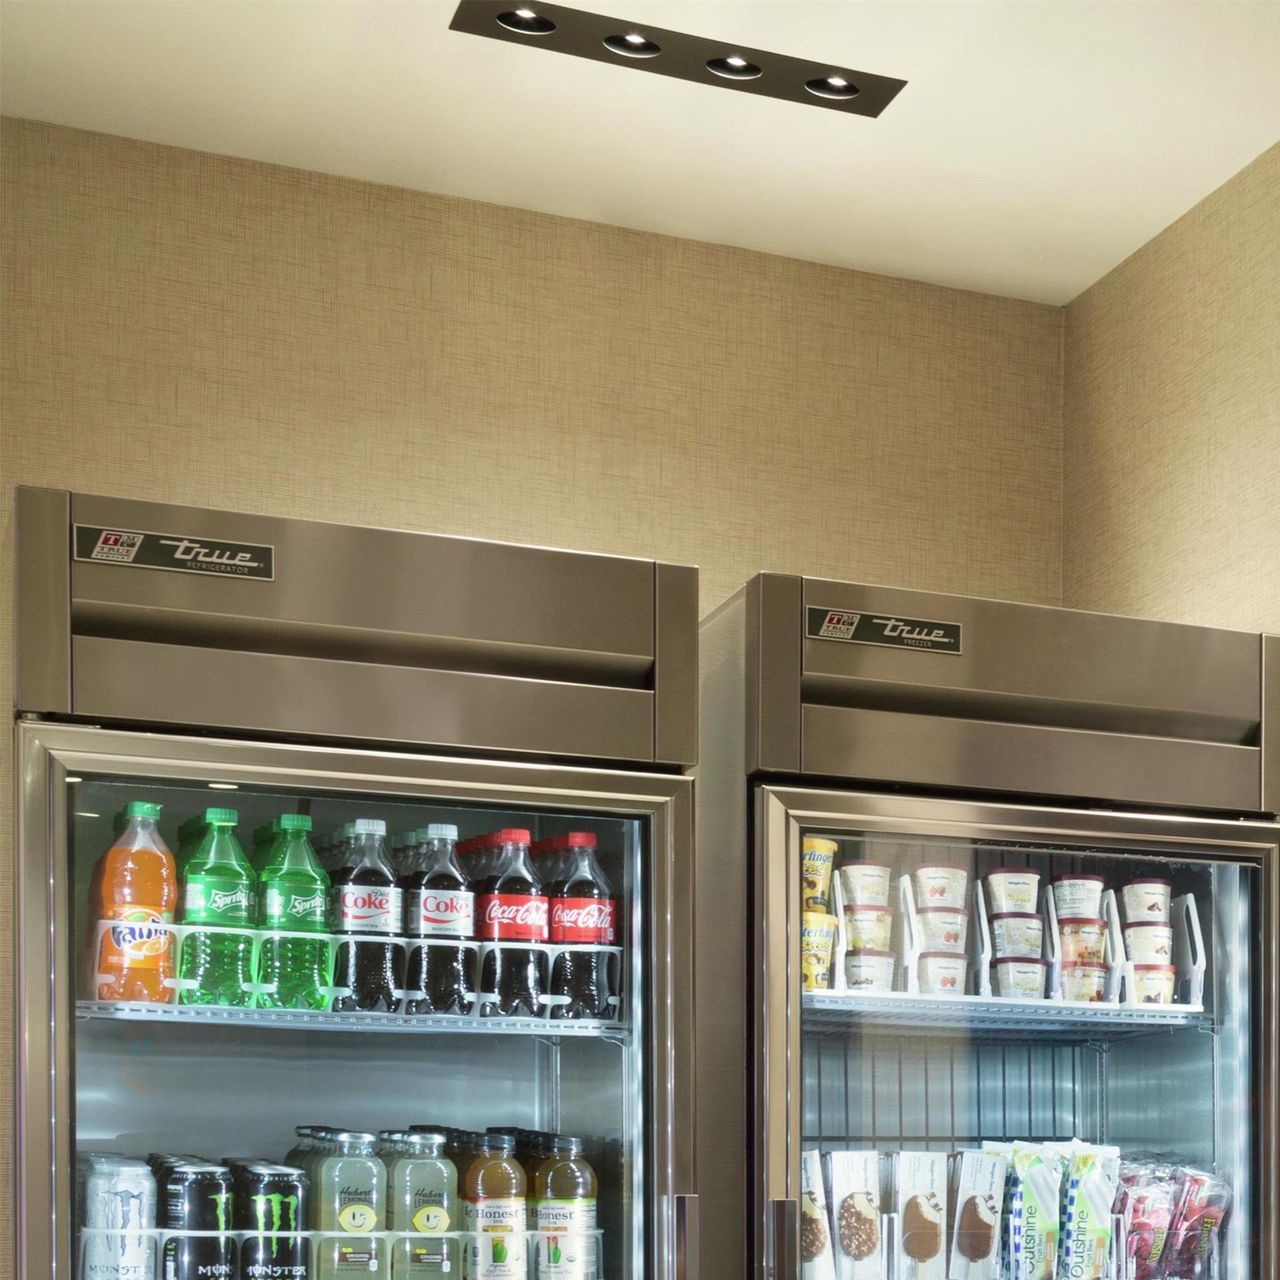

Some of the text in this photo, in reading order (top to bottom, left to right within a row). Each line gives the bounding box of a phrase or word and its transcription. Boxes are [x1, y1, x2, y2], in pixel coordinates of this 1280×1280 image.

[159, 540, 260, 568] true
[186, 560, 250, 575] REFRIGERATOR
[872, 619, 951, 643] true
[903, 638, 932, 648] FREEZER
[341, 891, 390, 910] Coke
[422, 895, 470, 914] Coke
[476, 1208, 519, 1219] Honest
[1070, 1210, 1089, 1278] Outshine
[247, 1264, 307, 1277] MONSTER
